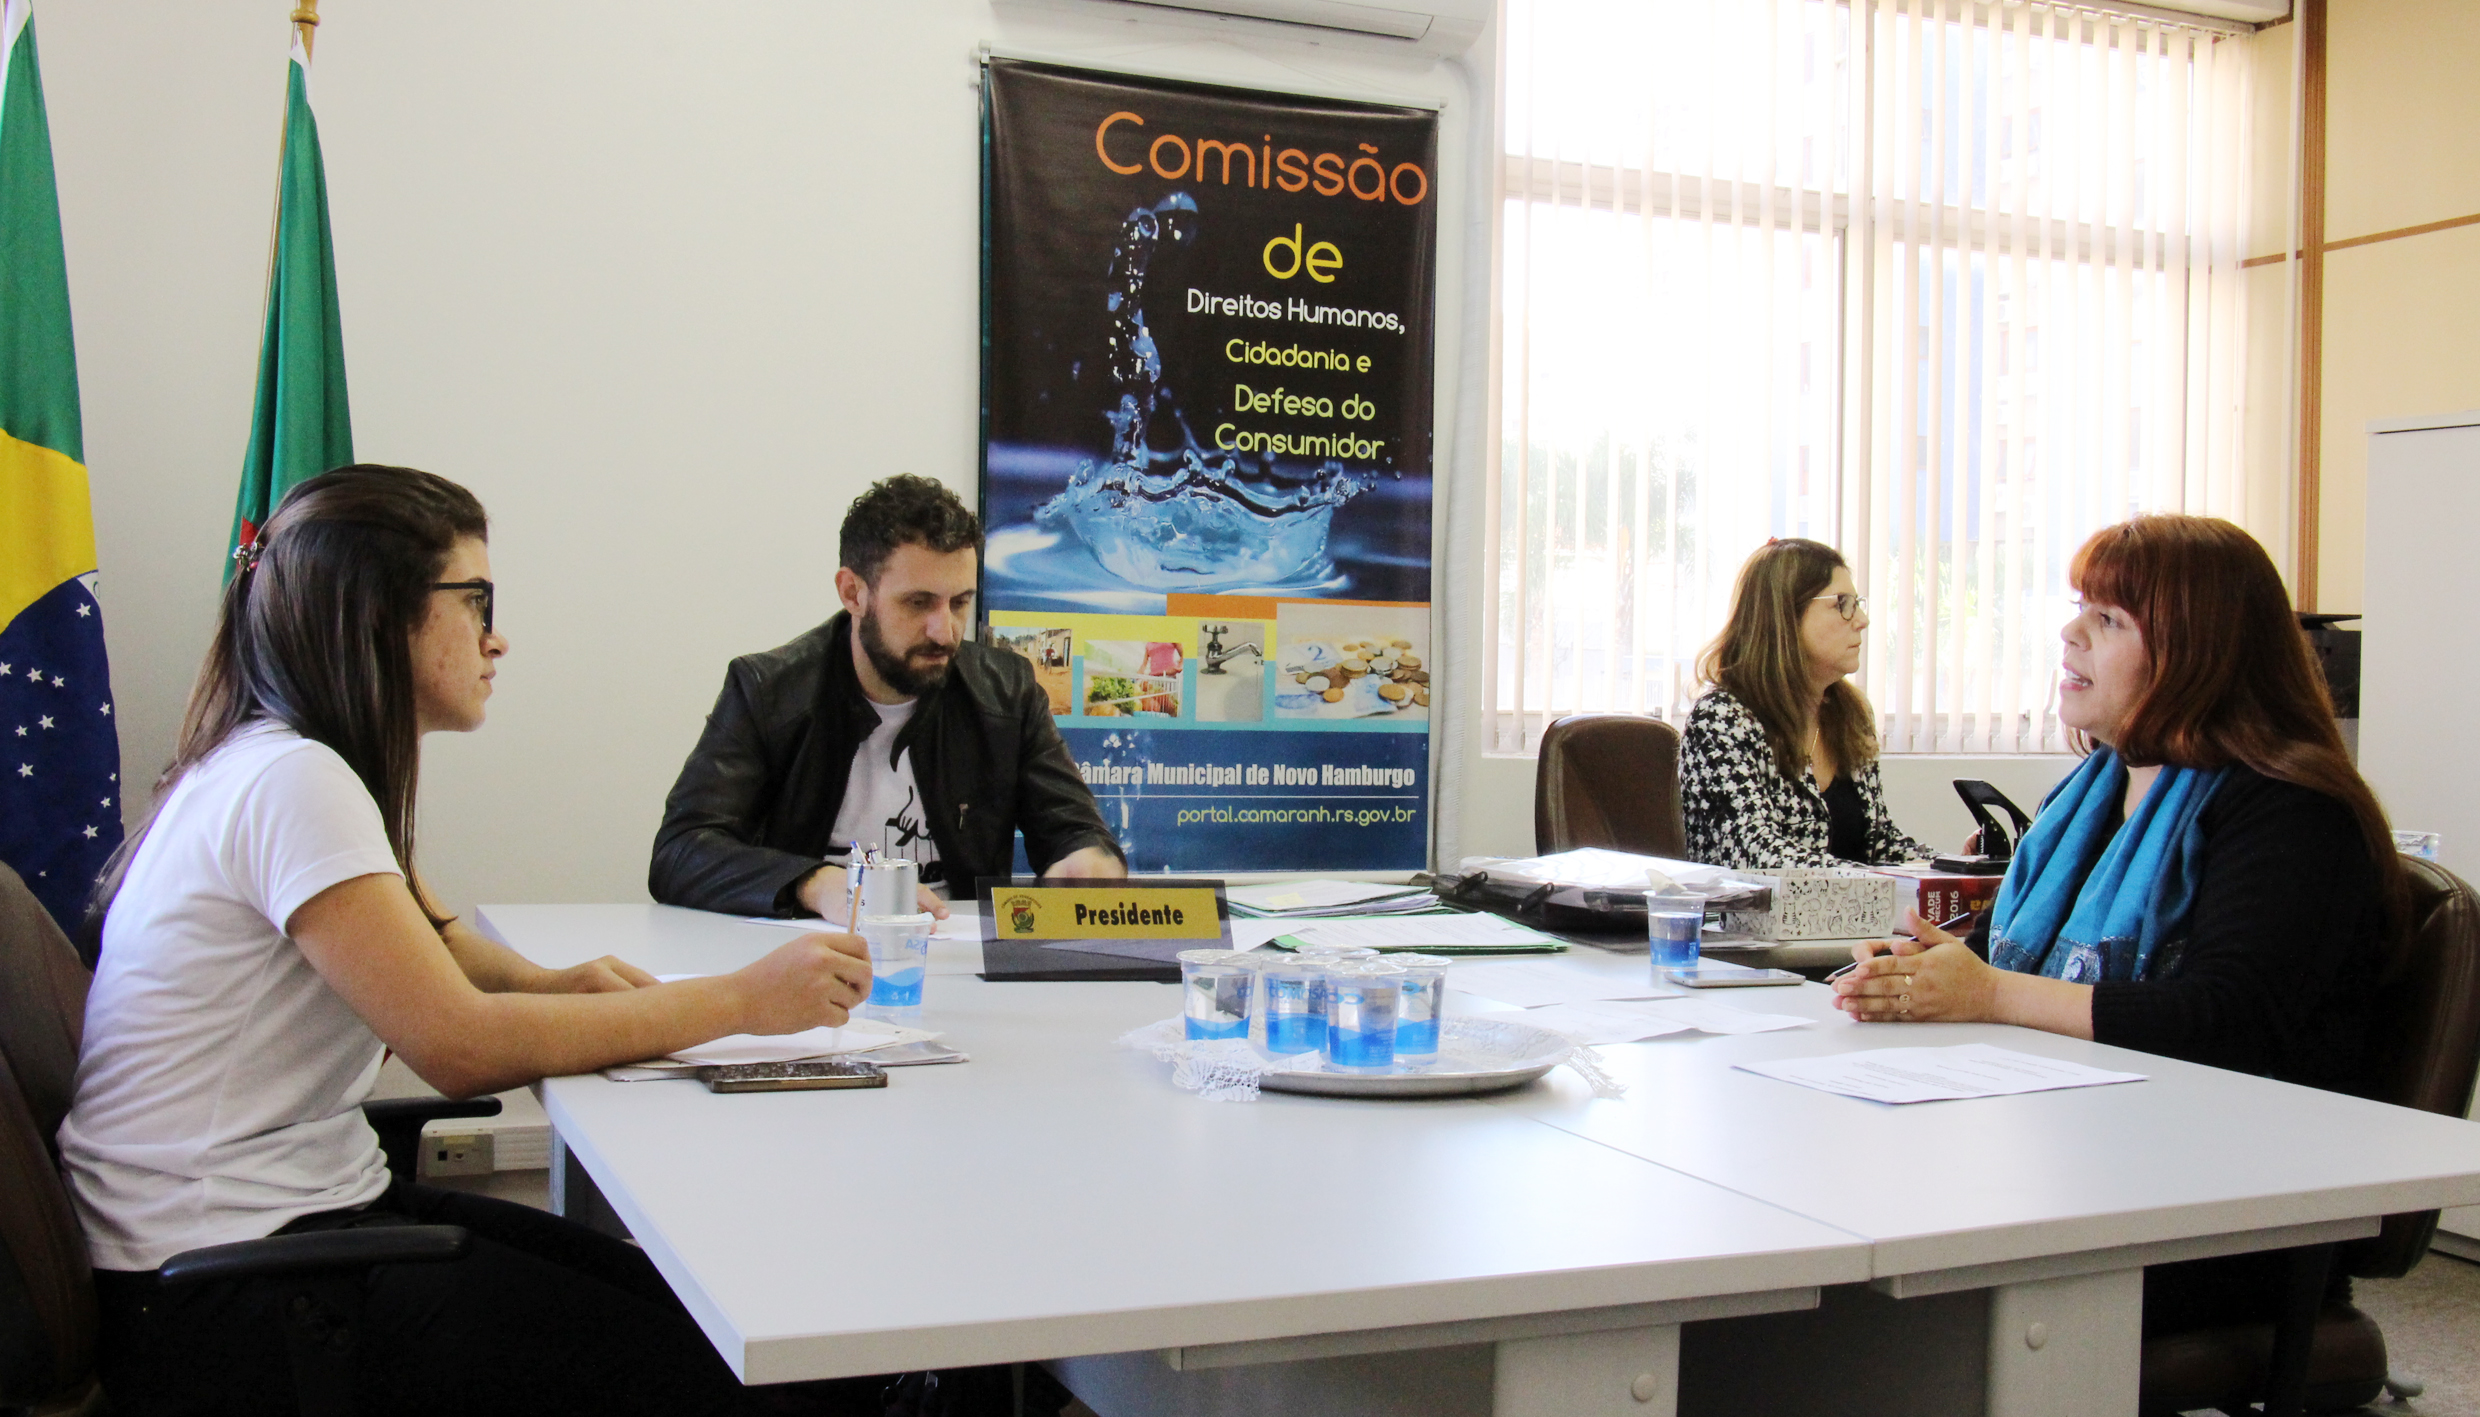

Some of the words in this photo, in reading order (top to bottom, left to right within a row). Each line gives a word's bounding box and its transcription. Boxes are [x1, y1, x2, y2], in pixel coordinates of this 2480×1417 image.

[1096, 111, 1427, 206] Comissão
[1263, 223, 1343, 283] de
[1187, 289, 1281, 321] Direitos
[1287, 298, 1406, 334] Humanos,
[1226, 339, 1350, 372] Cidadania
[1356, 356, 1372, 373] e
[1235, 384, 1334, 418] Defesa
[1341, 393, 1376, 421] do
[1215, 423, 1386, 460] Consumidor
[1147, 763, 1242, 787] Municipal
[1246, 764, 1269, 785] de
[1273, 764, 1318, 786] Novo
[1322, 764, 1416, 789] Hamburgo
[1177, 806, 1417, 827] portal.camaranh.rs.gov.br
[1074, 901, 1184, 925] Presidente
